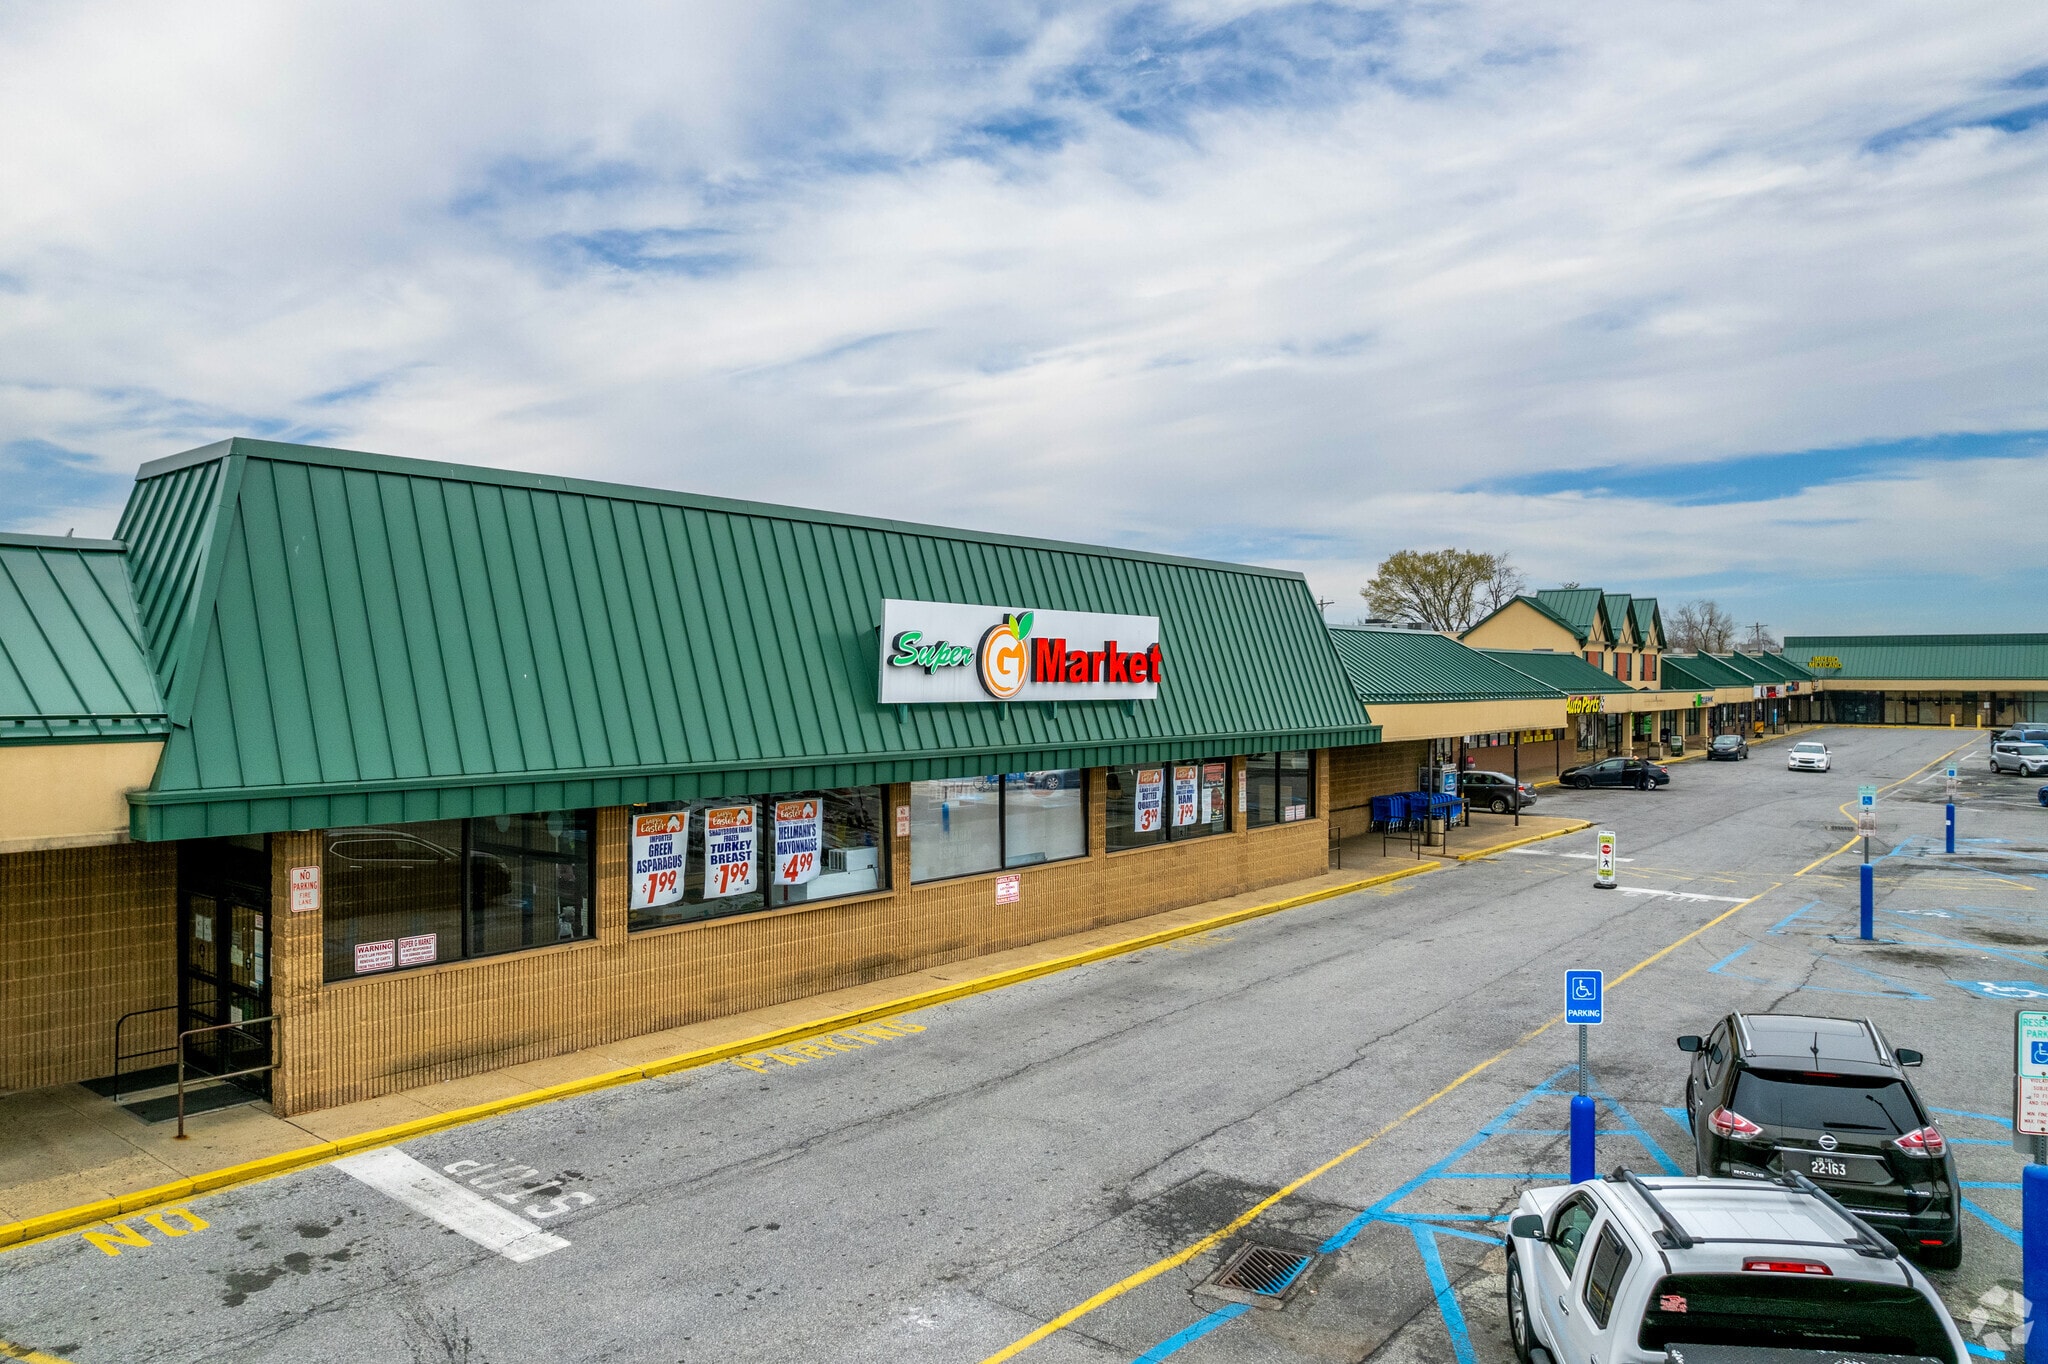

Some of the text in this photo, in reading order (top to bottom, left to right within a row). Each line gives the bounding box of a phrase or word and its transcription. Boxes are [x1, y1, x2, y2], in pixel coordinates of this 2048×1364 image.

[893, 631, 1162, 690] Super G Market
[1566, 696, 1600, 714] Auto Parts
[1142, 792, 1157, 801] BUTTER
[1178, 794, 1193, 805] HAM
[1137, 800, 1160, 810] QUARTERS
[780, 809, 802, 819] Easter
[712, 815, 736, 826] Easter
[640, 822, 667, 833] Easter
[778, 823, 817, 841] HELLMANN'S
[649, 833, 673, 844] IMPORTED
[723, 834, 740, 842] FROZEN
[648, 842, 673, 858] GREEN
[710, 839, 752, 854] TURKEY
[777, 838, 817, 856] MAYONNAISE
[710, 850, 752, 866] BREAST
[636, 854, 683, 874] ASPARAGUS
[299, 871, 311, 880] NO
[292, 881, 318, 891] PARKING
[299, 891, 311, 899] FIRE
[298, 898, 312, 906] LANE
[357, 942, 393, 954] WARNING
[400, 940, 413, 949] SUPER
[418, 937, 434, 946] MARKET
[1568, 1009, 1600, 1017] PARKING
[731, 1019, 927, 1074] PARKING
[1733, 1168, 1765, 1178] ROGUE
[443, 1158, 597, 1219] STOP
[82, 1207, 210, 1257] NO
